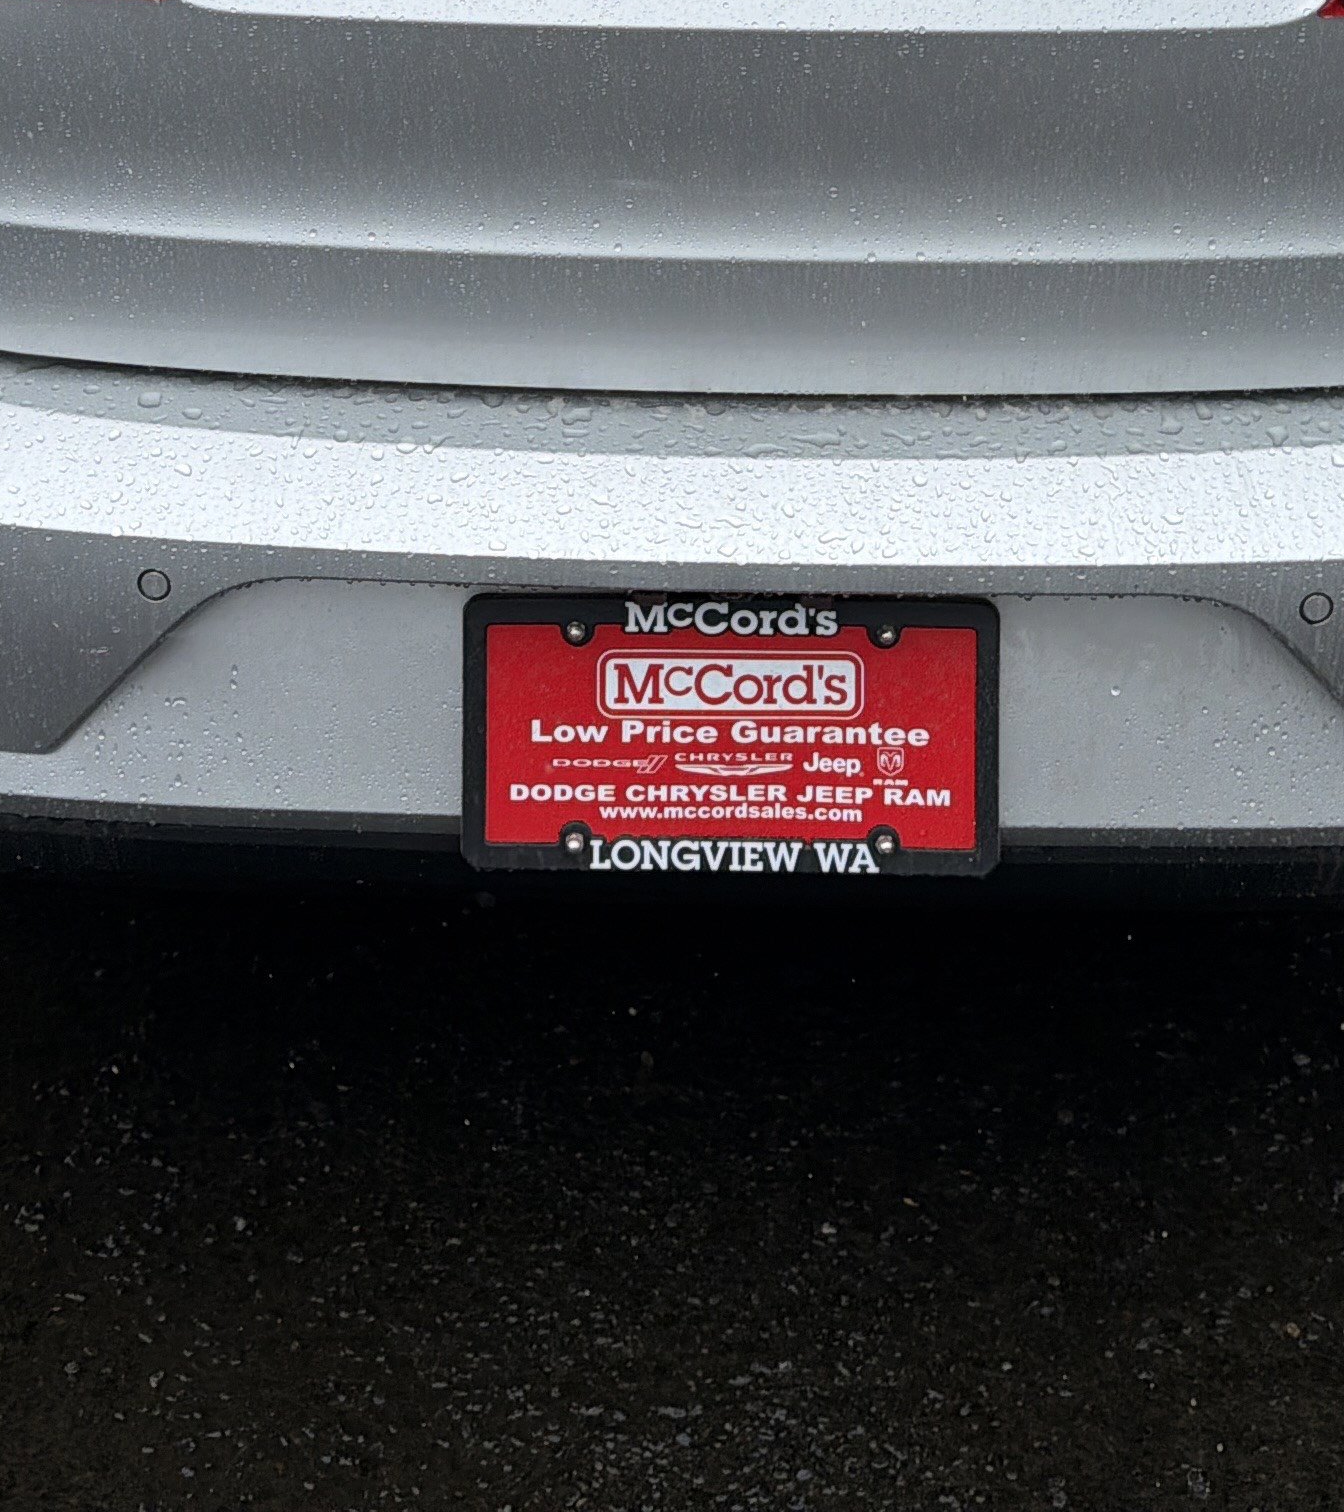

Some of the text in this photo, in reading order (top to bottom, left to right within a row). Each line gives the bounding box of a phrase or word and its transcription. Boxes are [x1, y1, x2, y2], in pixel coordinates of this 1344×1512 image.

[624, 601, 839, 637] McCord's
[613, 662, 848, 706] McCord's
[531, 719, 930, 746] Low Price Guarantee
[552, 758, 649, 768] DODGE
[674, 752, 793, 762] CHRYSLER
[803, 752, 861, 777] Jeep
[509, 783, 951, 807] DODGE CHRYSLER JEEP RAM
[598, 803, 863, 823] www.mccordsales.com
[589, 839, 880, 874] LONGVIEW WA
